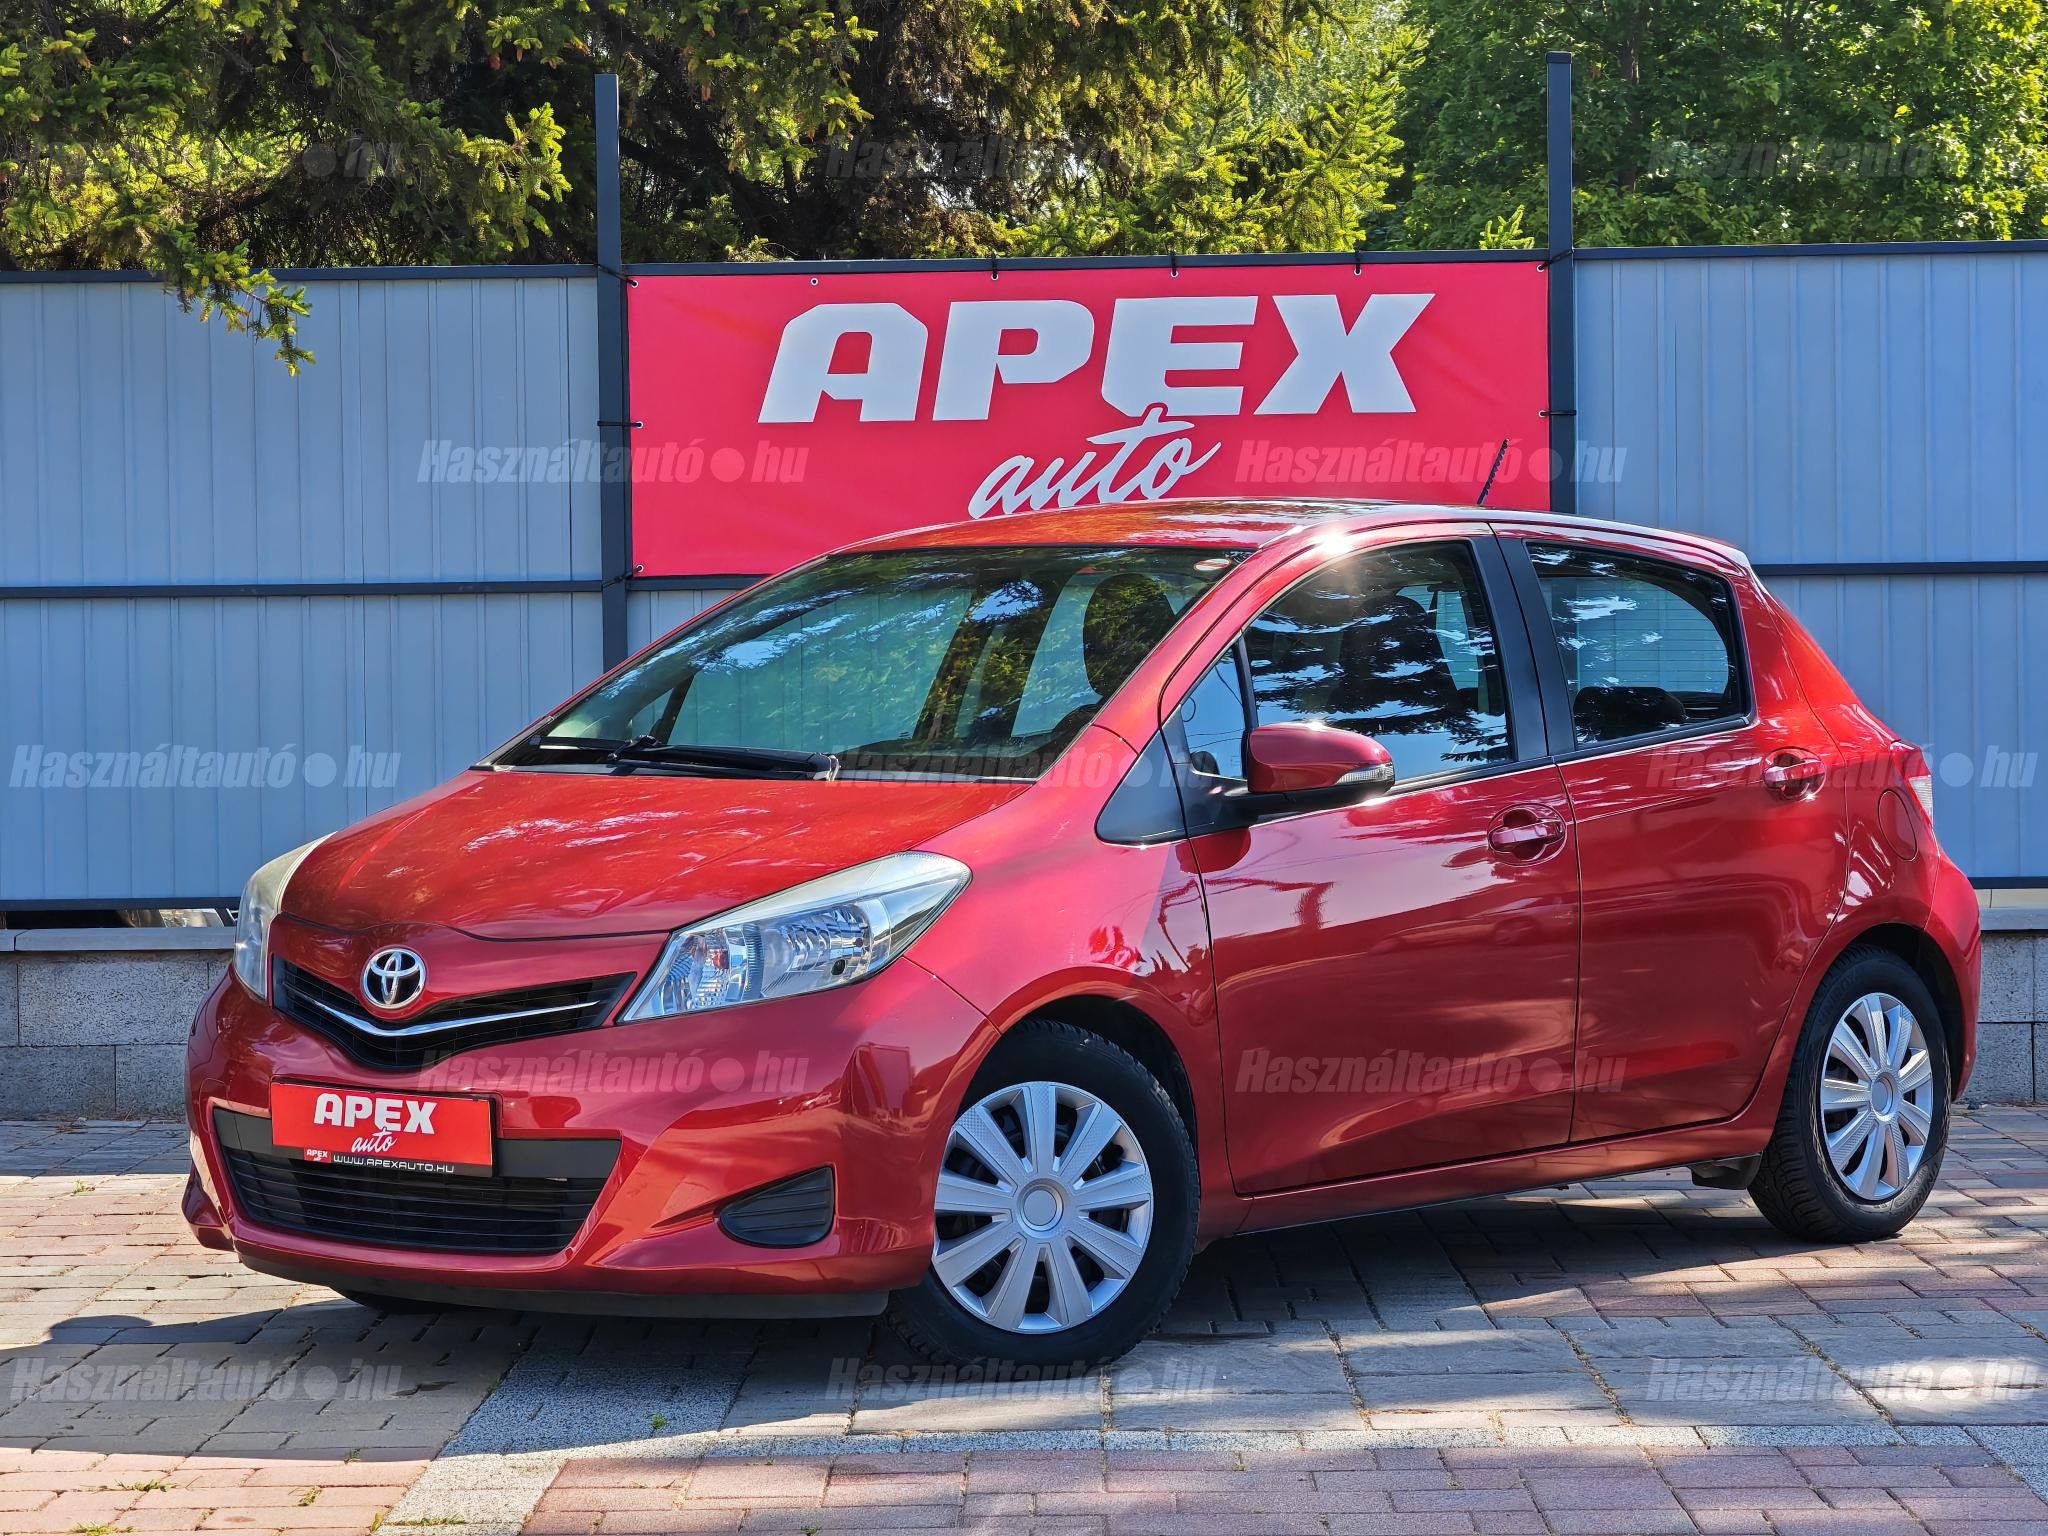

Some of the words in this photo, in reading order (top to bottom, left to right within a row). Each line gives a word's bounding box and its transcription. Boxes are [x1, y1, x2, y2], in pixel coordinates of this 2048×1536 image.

[758, 293, 1435, 424] APEX
[967, 407, 1222, 519] auto
[313, 1092, 438, 1135] APEX
[306, 1148, 328, 1158] APEX
[351, 1127, 398, 1153] auto
[333, 1154, 455, 1173] WWW.APEXAUTO.HU
